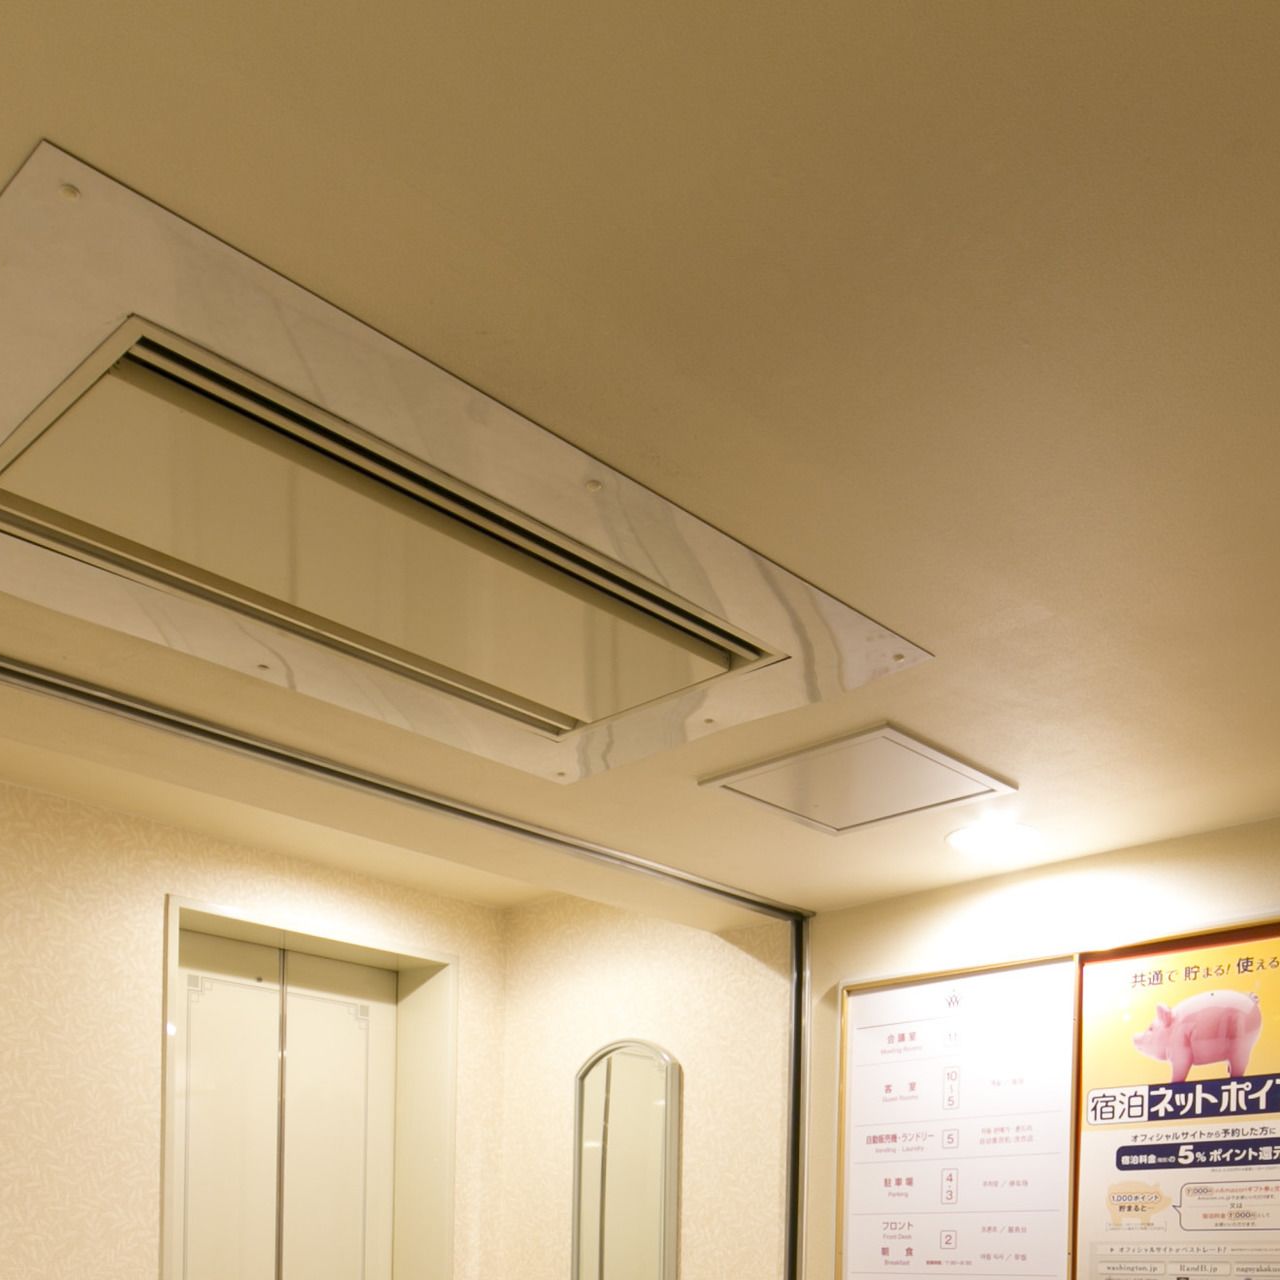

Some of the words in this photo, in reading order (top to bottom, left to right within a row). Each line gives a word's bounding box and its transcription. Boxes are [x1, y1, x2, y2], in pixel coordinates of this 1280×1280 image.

[947, 1134, 954, 1144] 5
[1131, 1126, 1276, 1143] オフィシャルサイトから予約した方に
[946, 1174, 953, 1182] 4
[946, 1190, 953, 1200] 3
[882, 1221, 914, 1230] フロント
[945, 1234, 952, 1244] 2
